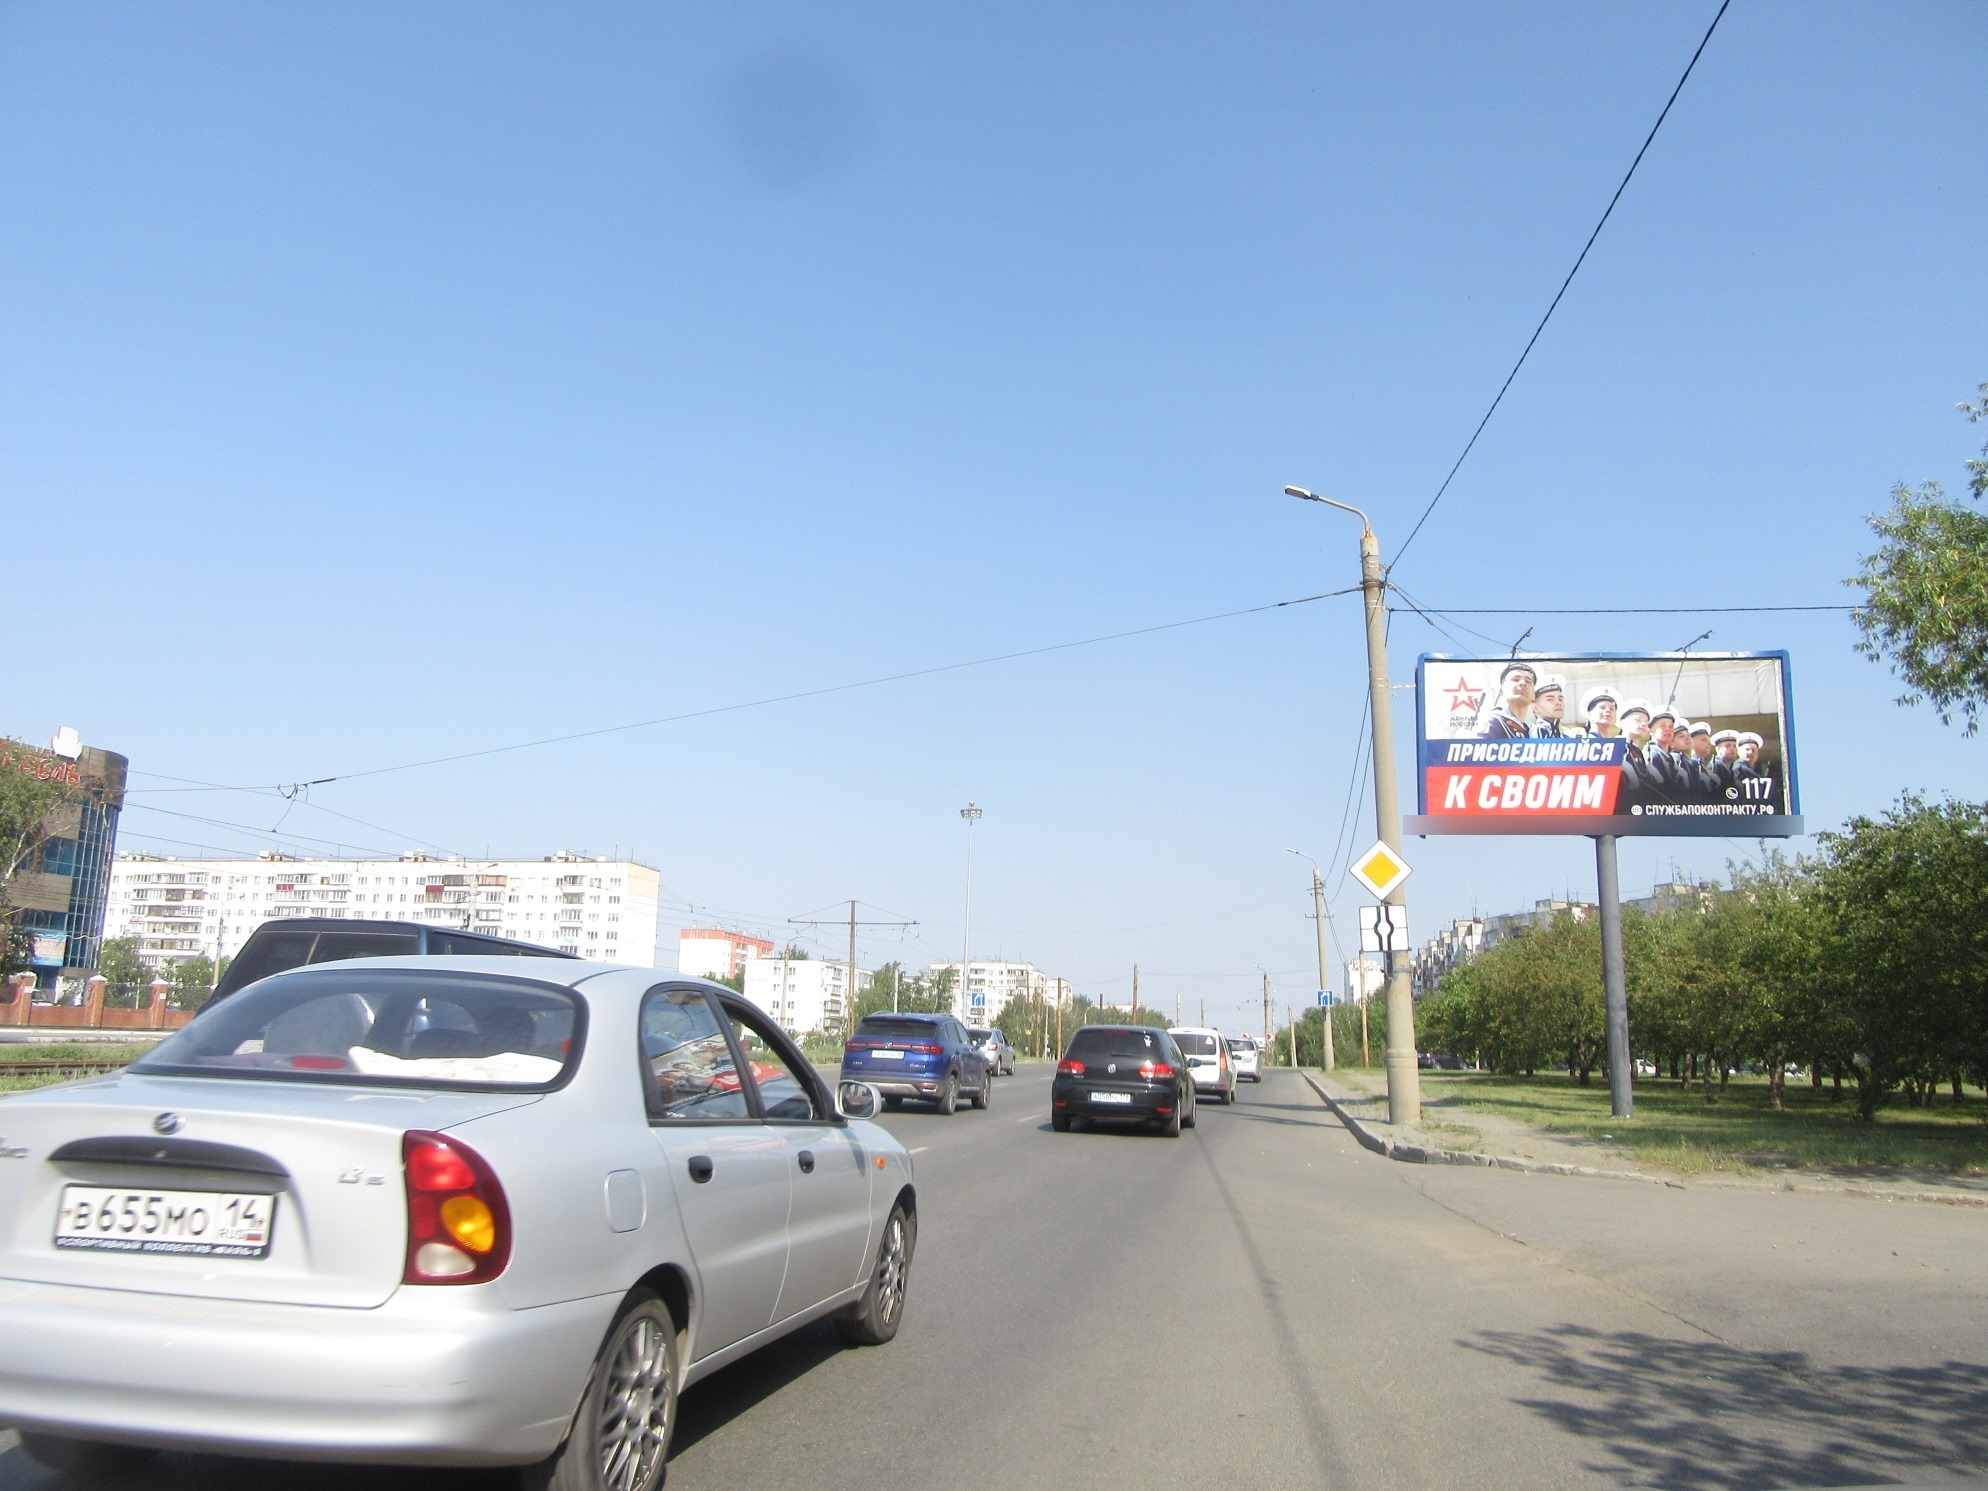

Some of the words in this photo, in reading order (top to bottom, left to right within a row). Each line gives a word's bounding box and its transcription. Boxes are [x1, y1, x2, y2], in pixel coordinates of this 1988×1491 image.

[1447, 740, 1614, 763] ПРИСОЕДИНЯЙСЯ
[1444, 775, 1472, 809] К
[1478, 774, 1606, 809] СВОИМ
[1741, 777, 1773, 800] 117
[1645, 805, 1773, 815] СЛУЖБАПОКОНТРАКТУ.РФ
[73, 1194, 210, 1236] В655МО
[225, 1197, 258, 1228] 14
